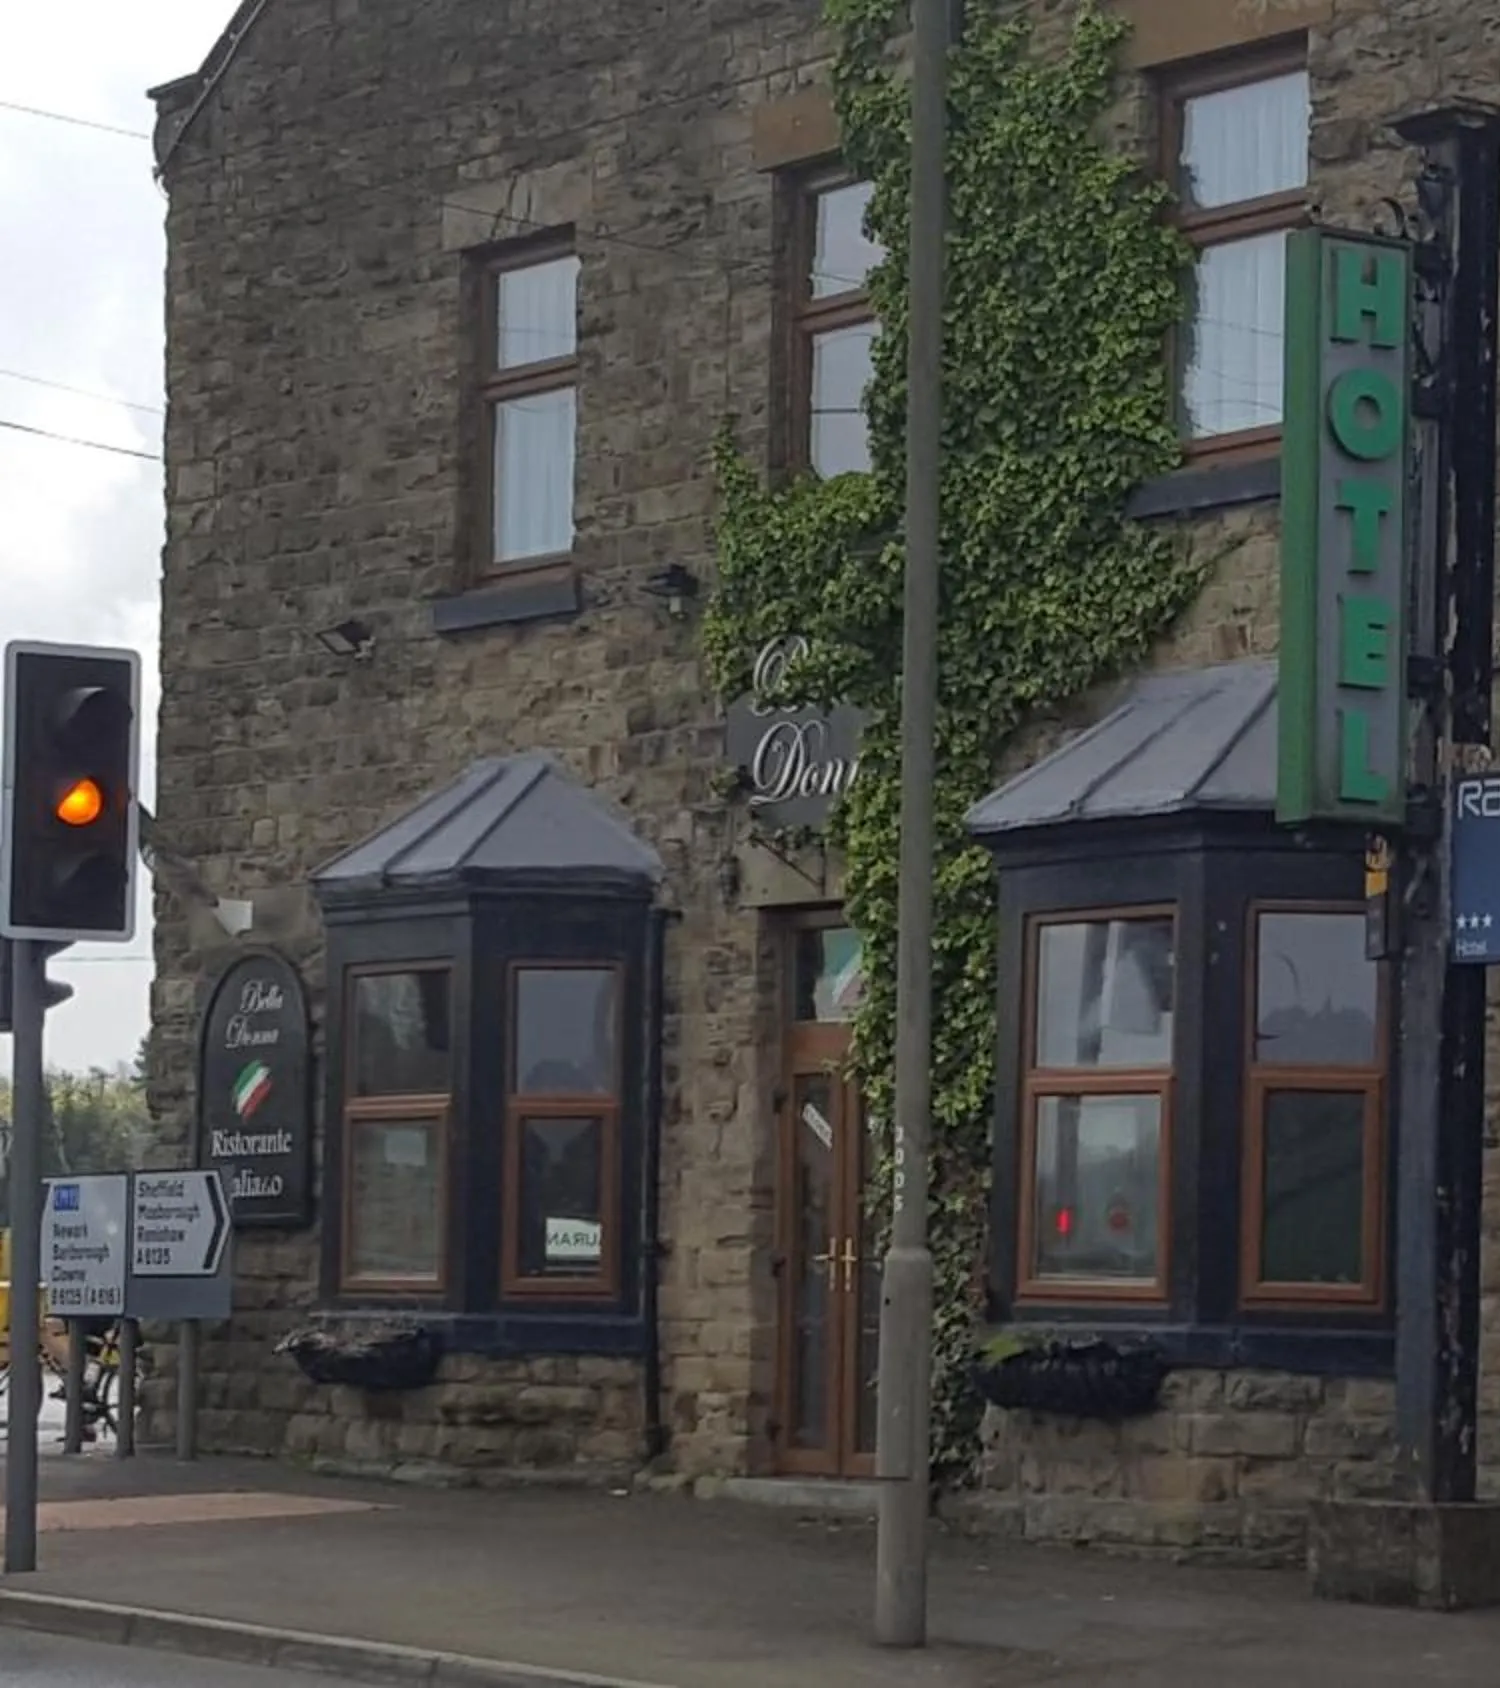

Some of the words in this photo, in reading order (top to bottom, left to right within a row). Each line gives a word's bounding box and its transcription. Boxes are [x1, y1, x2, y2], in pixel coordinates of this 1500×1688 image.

[1329, 246, 1401, 805] HOTEL
[211, 1128, 292, 1157] Ristorante
[138, 1180, 185, 1198] Sheffield
[136, 1247, 171, 1265] A6135
